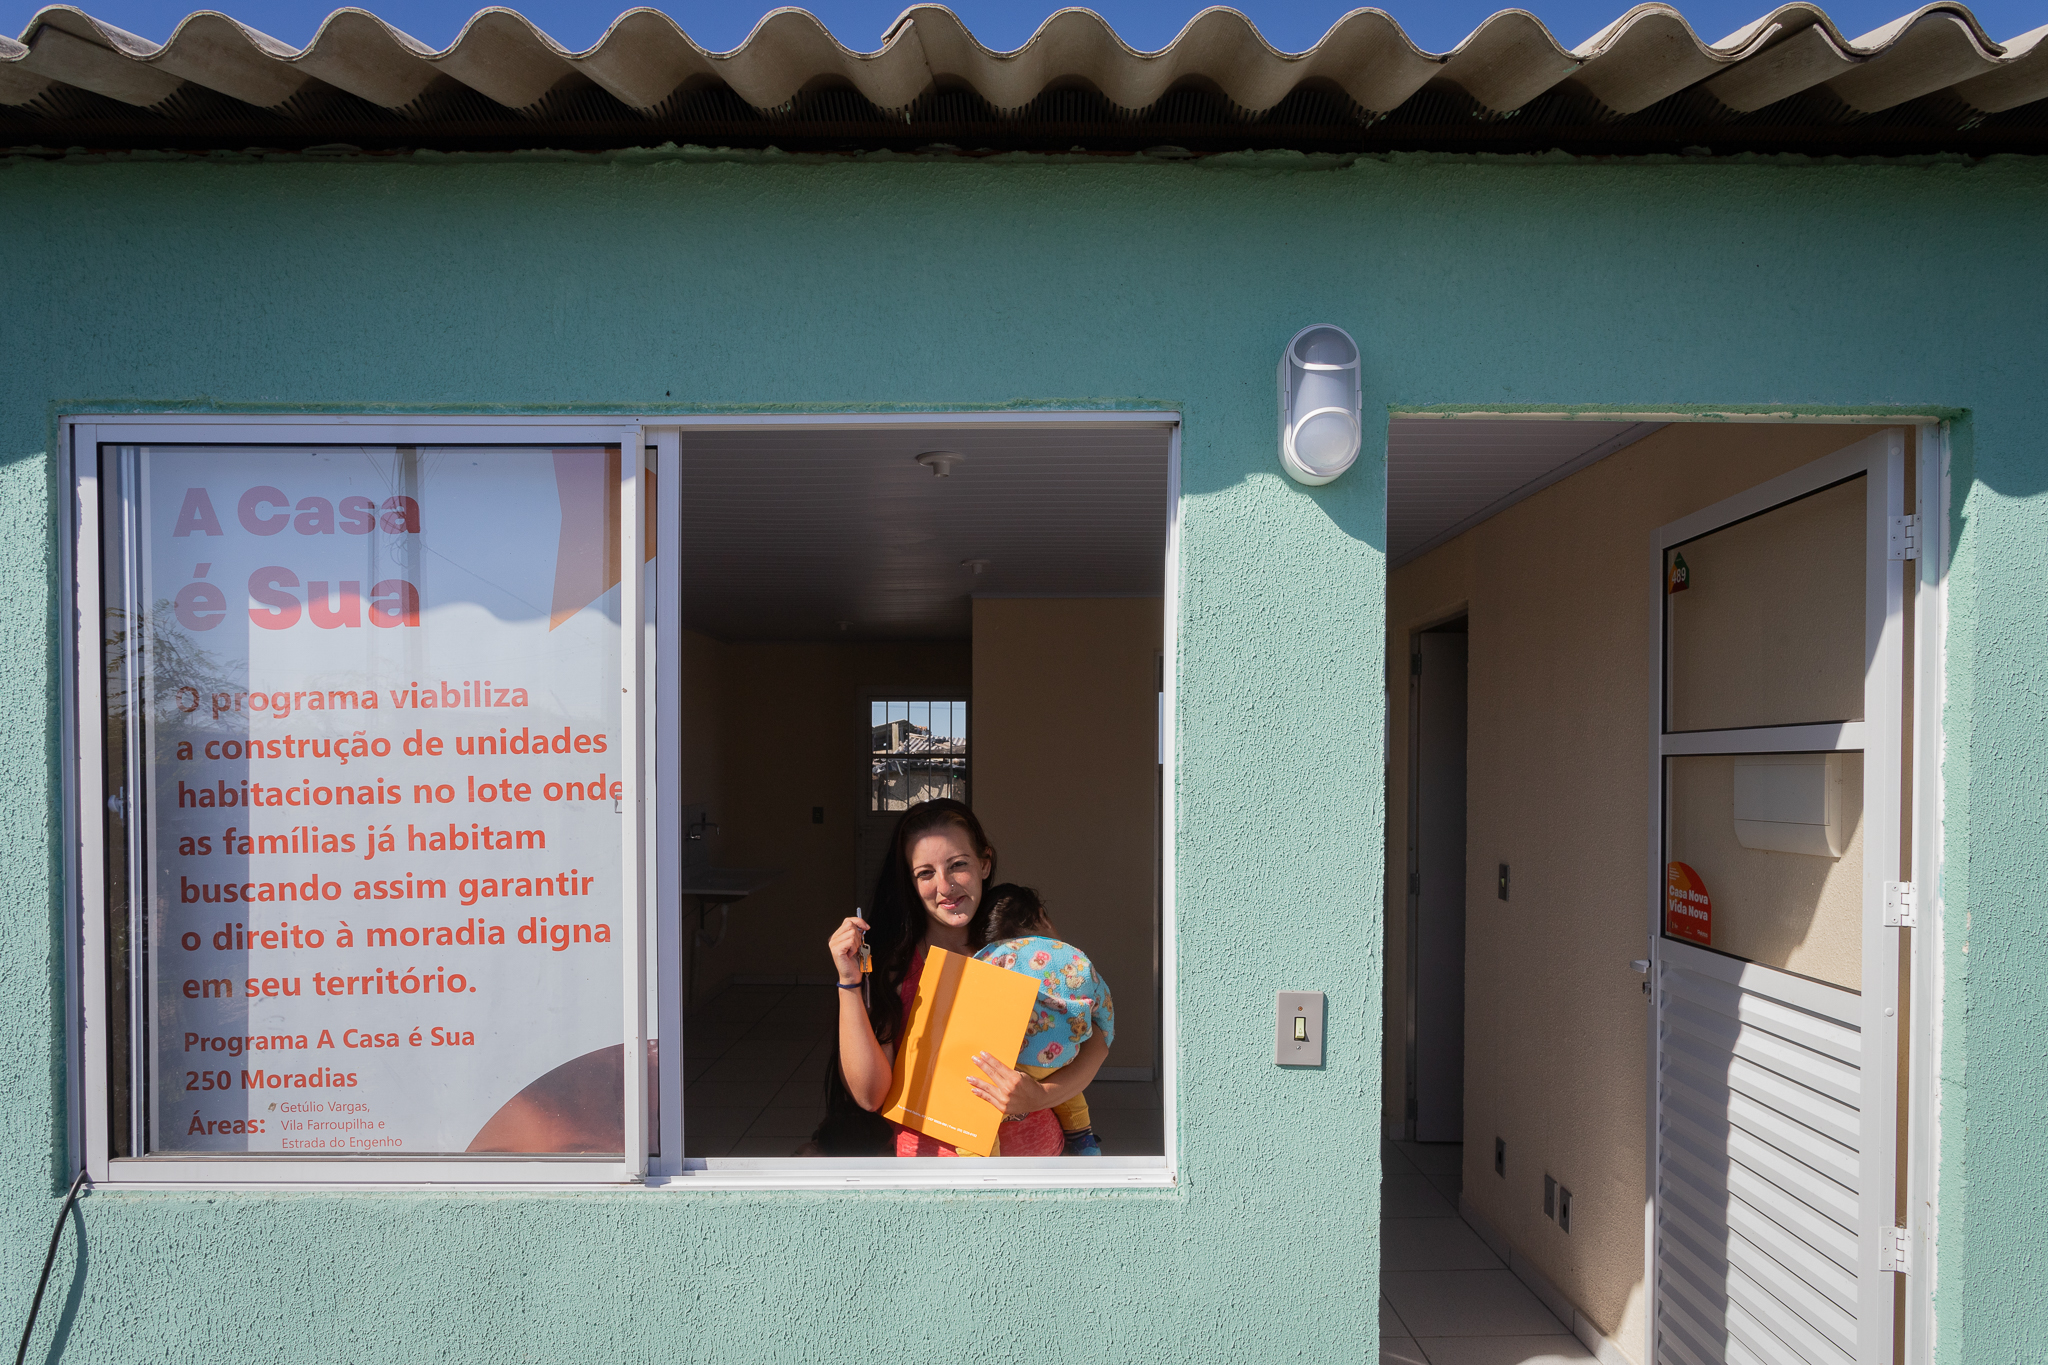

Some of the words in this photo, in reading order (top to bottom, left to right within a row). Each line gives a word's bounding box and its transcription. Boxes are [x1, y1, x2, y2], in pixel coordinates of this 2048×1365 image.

[174, 488, 223, 537] A
[238, 486, 421, 536] Casa
[1672, 567, 1686, 584] 489
[174, 563, 226, 631] é
[248, 567, 420, 630] Sua
[176, 686, 201, 712] O
[212, 689, 378, 719] programa
[390, 681, 528, 708] viabiliza
[177, 742, 193, 760] a
[206, 730, 391, 765] construção
[403, 729, 443, 756] de
[456, 727, 607, 755] unidades
[180, 778, 401, 807] habitacionais
[414, 784, 455, 803] no
[468, 776, 531, 802] lote
[543, 773, 622, 801] onde
[178, 835, 212, 856] as
[223, 826, 355, 854] famílias
[364, 825, 395, 860] já
[408, 823, 545, 851] habitam
[182, 874, 341, 902] buscando
[354, 872, 446, 900] assim
[459, 869, 593, 906] garantir
[1669, 885, 1687, 899] Casa
[1689, 889, 1709, 905] Nova
[1669, 899, 1687, 915] Vida
[1688, 905, 1708, 921] Nova
[181, 932, 200, 951] o
[214, 922, 324, 950] direito
[336, 921, 353, 948] à
[367, 918, 504, 947] moradia
[518, 917, 610, 951] digna
[183, 979, 232, 998] em
[246, 978, 300, 997] seu
[313, 966, 476, 995] território.
[184, 1031, 308, 1057] Programa
[317, 1030, 335, 1048] A
[343, 1029, 399, 1048] Casa
[409, 1026, 422, 1046] é
[431, 1027, 474, 1046] Sua
[186, 1071, 231, 1090] 250
[242, 1067, 357, 1089] Moradias
[280, 1099, 323, 1113] Getúlio
[327, 1099, 370, 1114] Vargas,
[187, 1110, 267, 1135] Áreas:
[280, 1117, 303, 1131] Vila
[306, 1116, 374, 1132] Farroupilha
[378, 1120, 385, 1129] e
[281, 1136, 324, 1149] Estrada
[328, 1135, 346, 1148] do
[349, 1134, 402, 1149] Engenho
